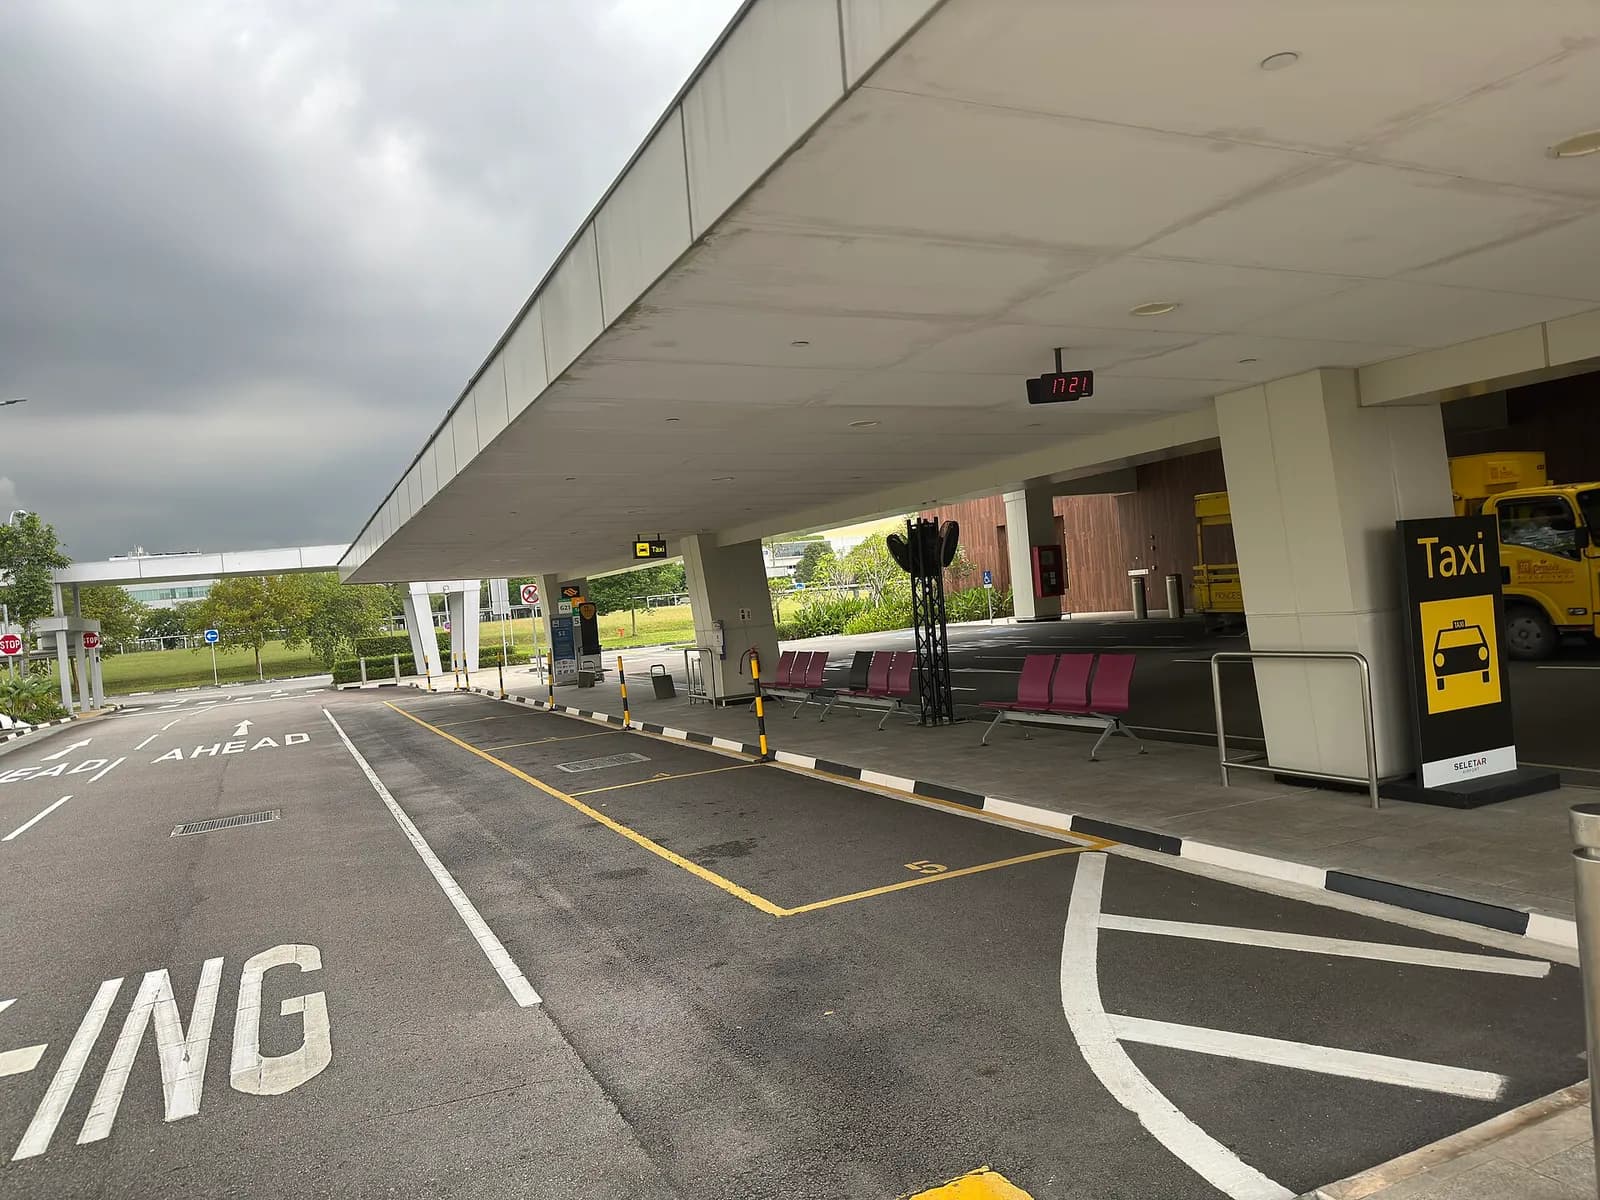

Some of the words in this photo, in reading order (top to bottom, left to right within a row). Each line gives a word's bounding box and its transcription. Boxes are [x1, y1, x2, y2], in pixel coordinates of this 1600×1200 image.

[651, 545, 665, 553] Taxi
[1417, 531, 1485, 578] Taxi
[0, 641, 20, 649] STOP
[150, 733, 311, 764] AHEAD
[0, 759, 109, 783] EAD
[1453, 757, 1487, 771] SELETAR
[904, 860, 949, 874] 5
